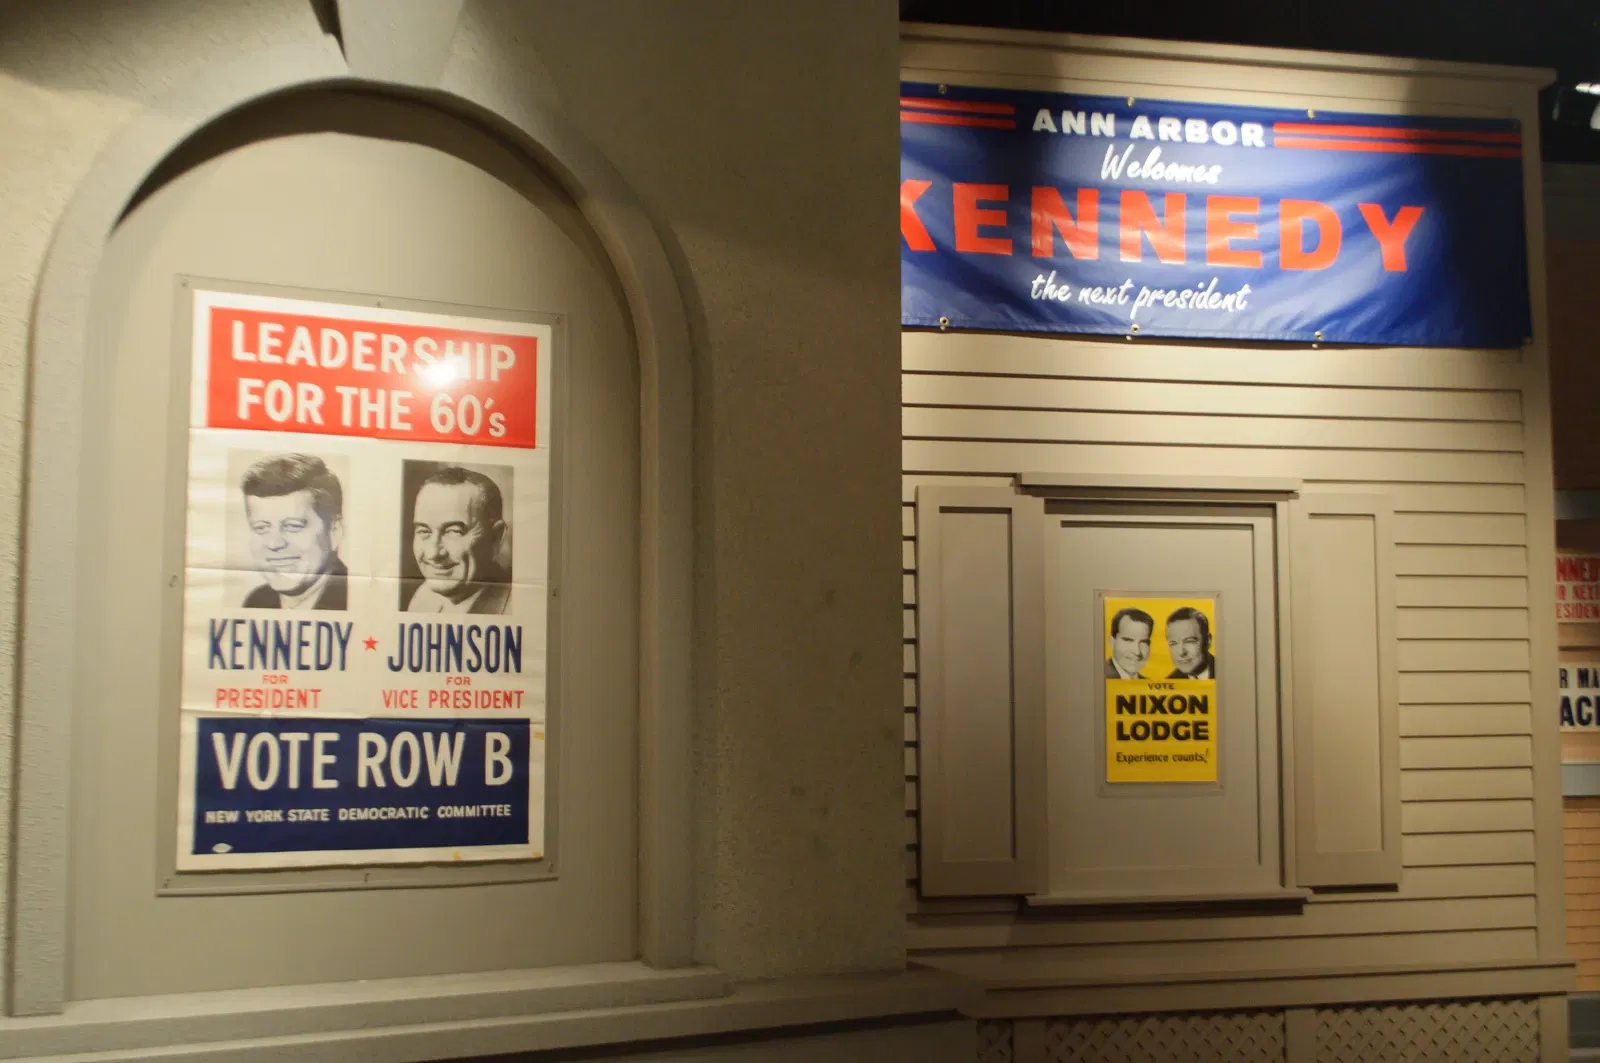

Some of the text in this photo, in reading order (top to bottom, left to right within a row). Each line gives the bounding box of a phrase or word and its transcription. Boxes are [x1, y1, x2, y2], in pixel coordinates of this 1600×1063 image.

[1032, 109, 1265, 148] ANN ARBOR
[1100, 143, 1223, 184] Welcomes
[1030, 270, 1252, 320] the next president
[231, 320, 515, 382] LEADERSHIP
[237, 377, 507, 438] FOR THE 60's
[207, 618, 523, 673] KENNEDY JOHNSON
[262, 674, 289, 685] FOR
[446, 676, 471, 686] FOR
[215, 688, 322, 709] PRESIDENT
[382, 689, 524, 709] VICE PRESIDENT
[1116, 695, 1209, 715] NIXON
[1116, 720, 1209, 741] LODGE
[211, 731, 514, 791] VOTE ROW B
[1116, 752, 1168, 764] Experience
[204, 804, 512, 824] NEW YORK STATE DEMOCRATIC COMMITTEE
